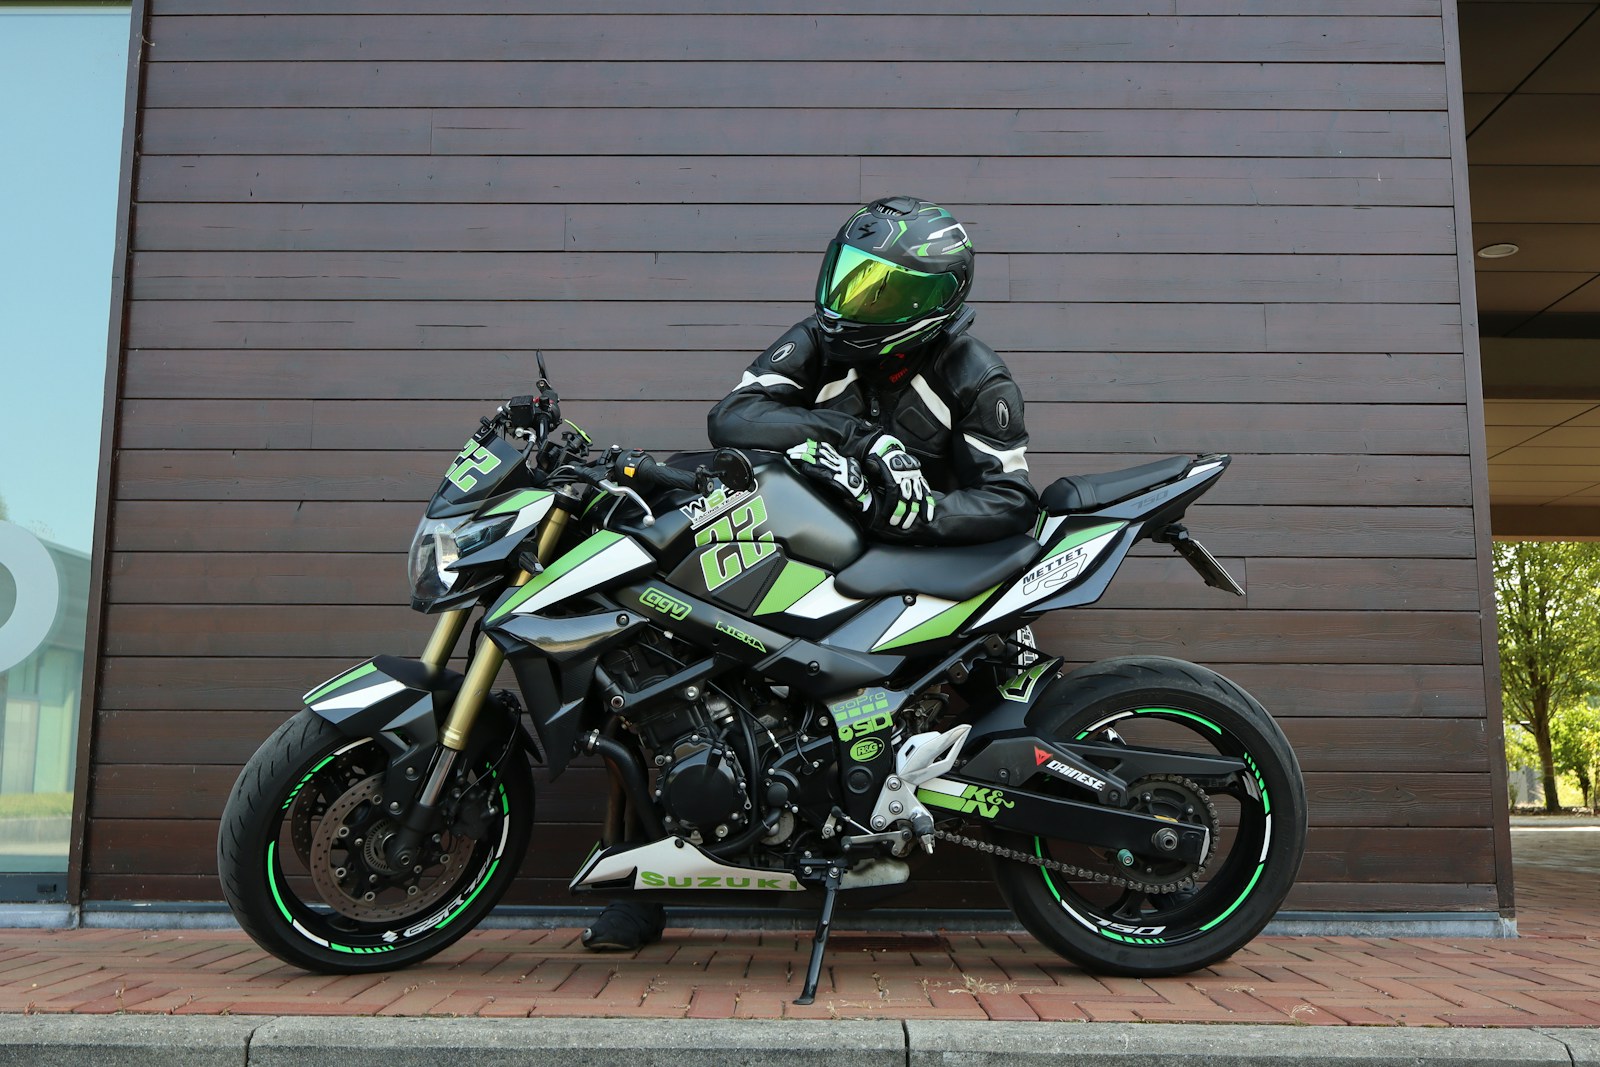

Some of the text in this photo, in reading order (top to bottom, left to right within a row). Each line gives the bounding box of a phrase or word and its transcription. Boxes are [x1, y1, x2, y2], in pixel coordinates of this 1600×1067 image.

[1130, 490, 1169, 510] 750
[695, 494, 776, 592] 22
[1023, 547, 1084, 584] METTET
[832, 691, 886, 713] GoPro
[1046, 759, 1106, 791] DAINESE
[641, 871, 797, 890] SUZUKI
[403, 894, 464, 937] GSR
[1088, 911, 1166, 935] 750
